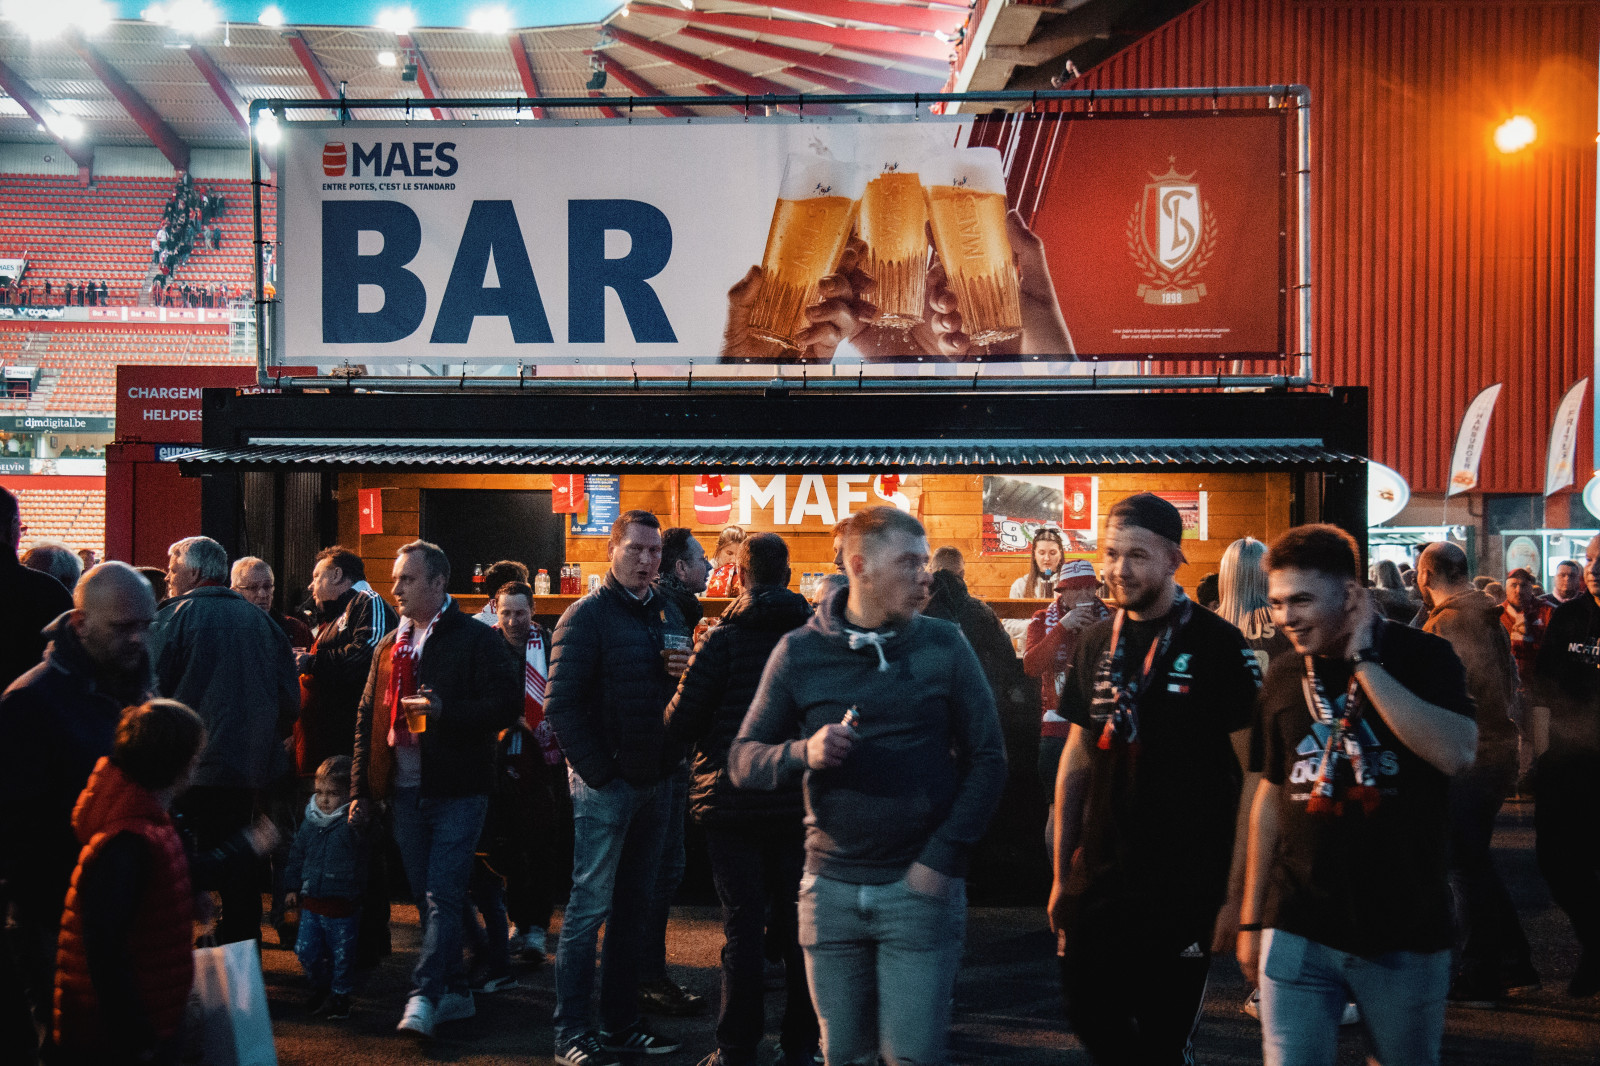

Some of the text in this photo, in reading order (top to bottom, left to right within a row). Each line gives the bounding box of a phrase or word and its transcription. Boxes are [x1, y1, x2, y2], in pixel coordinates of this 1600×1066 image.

[352, 142, 459, 177] MAES
[322, 183, 456, 192] ENTRE POTES, C'EST LE STANDARD
[321, 199, 679, 344] BAR
[1162, 293, 1182, 304] 1898
[128, 387, 202, 399] CHARGEM
[25, 418, 86, 428] djmdigital.be
